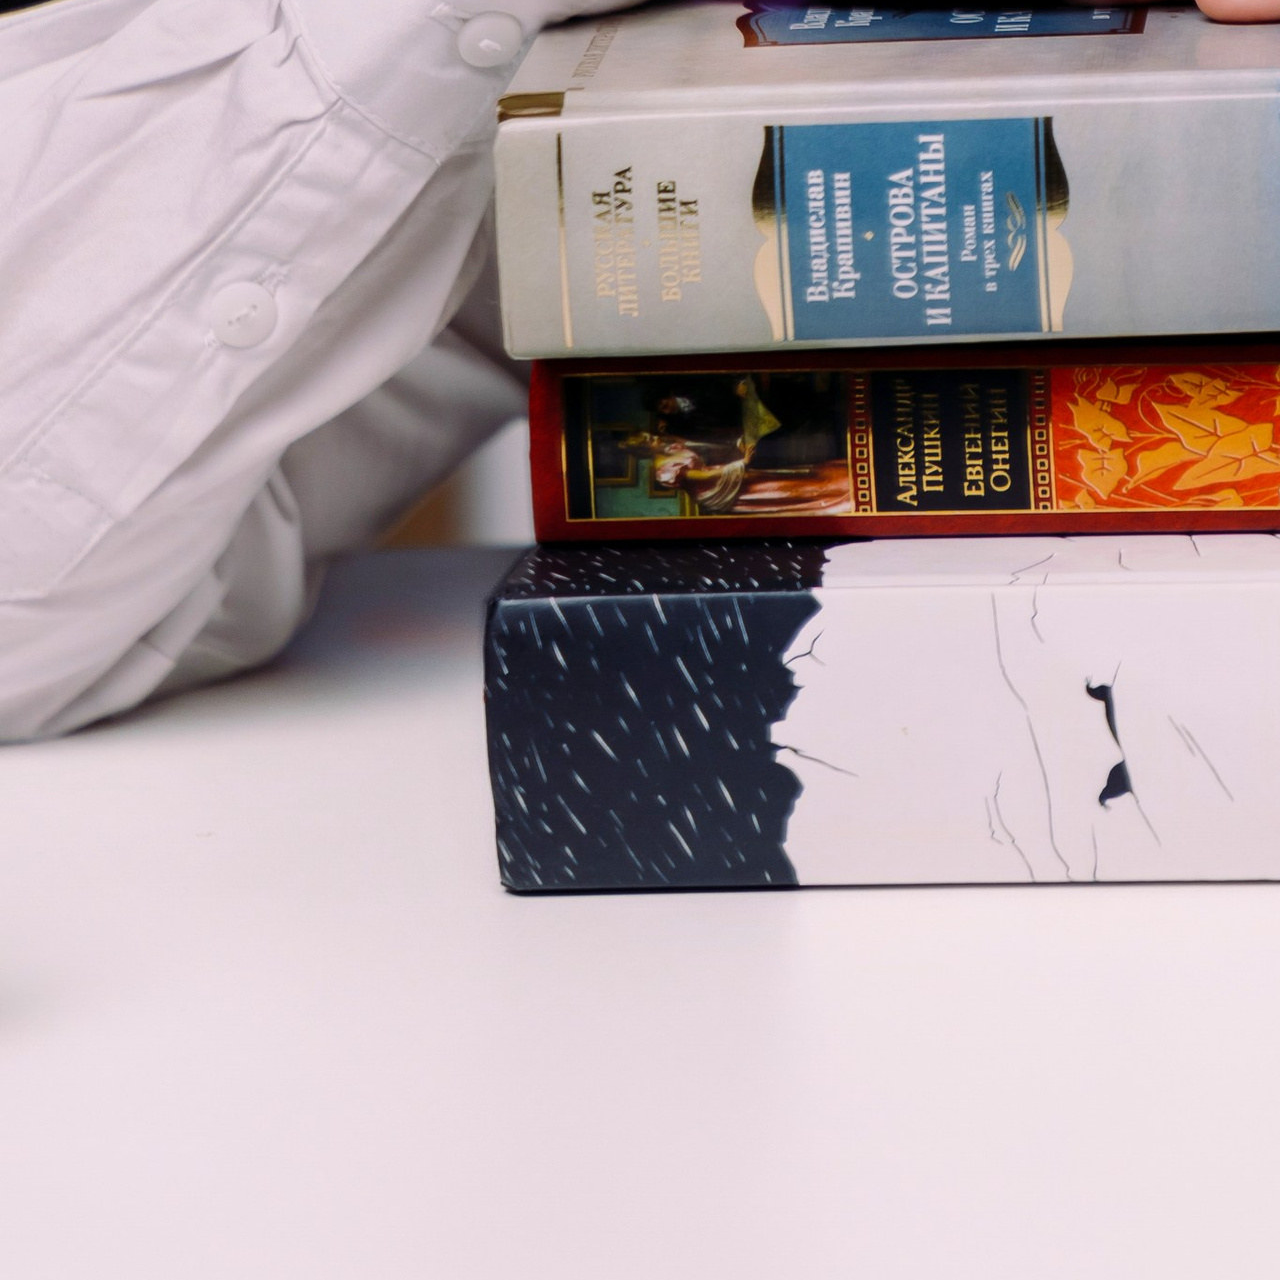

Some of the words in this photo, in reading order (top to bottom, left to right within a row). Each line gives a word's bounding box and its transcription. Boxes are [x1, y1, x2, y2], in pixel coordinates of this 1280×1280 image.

[592, 191, 617, 298] РУССКАЯ
[613, 166, 639, 318] ЛИТЕРАТУРА
[657, 180, 682, 302] БОЛЬШИЕ
[679, 199, 701, 283] КНИГИ
[806, 169, 831, 303] Владислав
[833, 171, 862, 299] Крапивин
[888, 167, 919, 299] ОСТРОВА
[918, 133, 951, 301] КАПИТАНЫ
[960, 204, 978, 262] Роман
[980, 170, 995, 234] книгах
[983, 239, 1001, 279] трех
[985, 281, 998, 292] в
[926, 306, 952, 326] И
[922, 393, 944, 492] ПУШКИН
[989, 387, 1011, 492] ОНЕГИН
